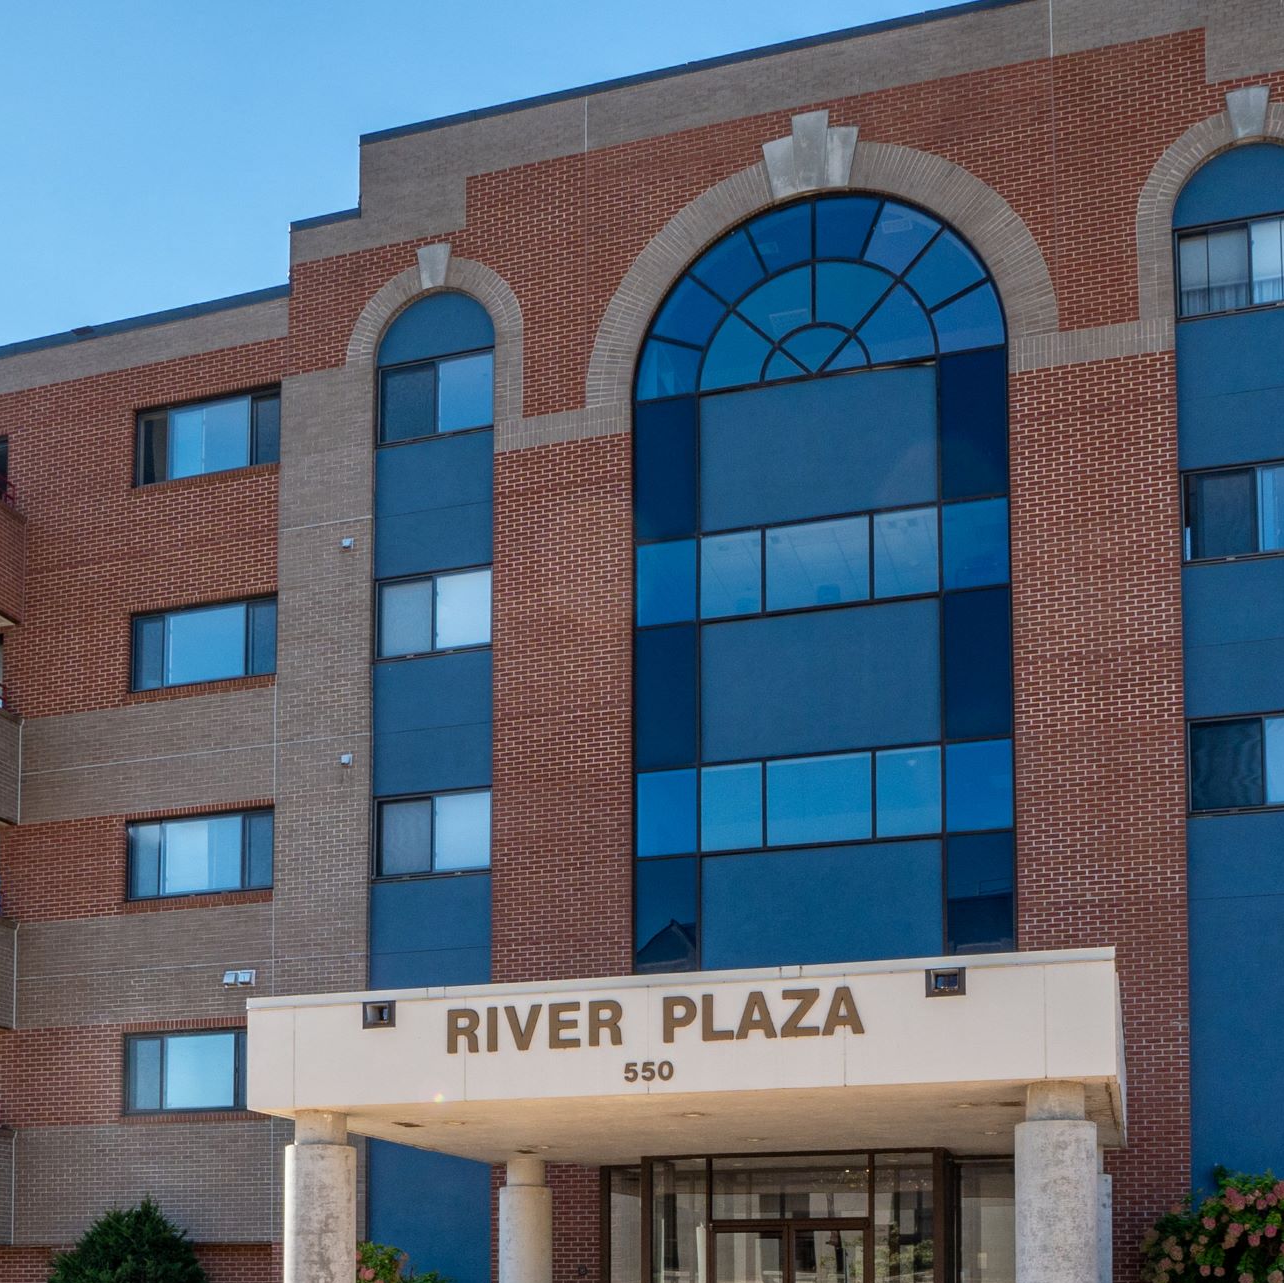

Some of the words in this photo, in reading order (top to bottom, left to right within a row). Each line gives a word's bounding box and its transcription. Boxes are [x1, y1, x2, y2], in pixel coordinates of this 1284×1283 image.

[446, 1000, 624, 1055] RIVER
[662, 986, 866, 1044] PLAZA
[623, 1060, 675, 1083] 550
